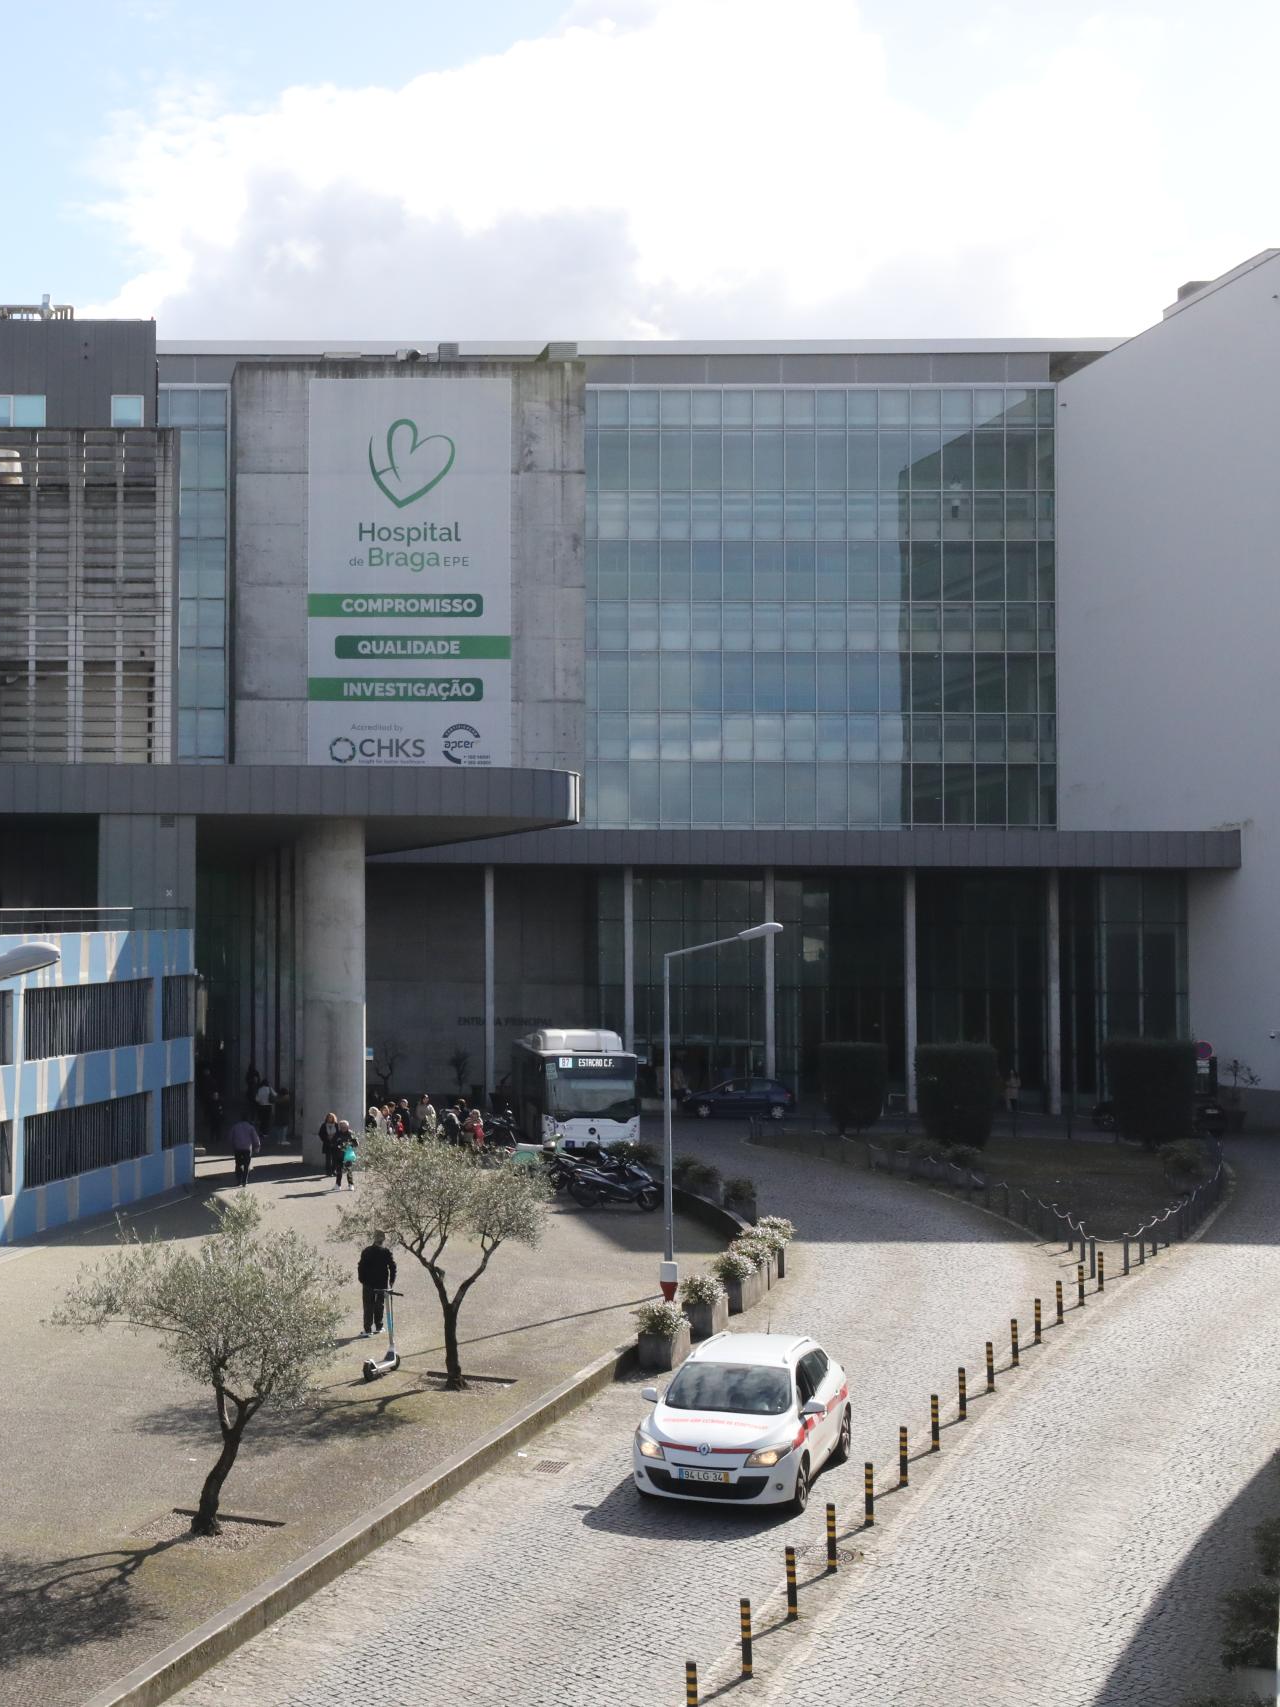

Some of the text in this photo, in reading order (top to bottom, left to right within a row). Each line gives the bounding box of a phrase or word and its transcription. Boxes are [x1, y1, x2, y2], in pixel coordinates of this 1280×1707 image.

[358, 521, 462, 547] Hospital
[349, 547, 470, 573] de Braga EPE
[341, 598, 477, 613] COMPROMISSO
[357, 640, 461, 655] QUALIDADE
[343, 679, 476, 701] INVESTIGAÇÃO
[358, 738, 425, 759] CHKS
[444, 740, 474, 751] apcer
[697, 1471, 710, 1481] LG
